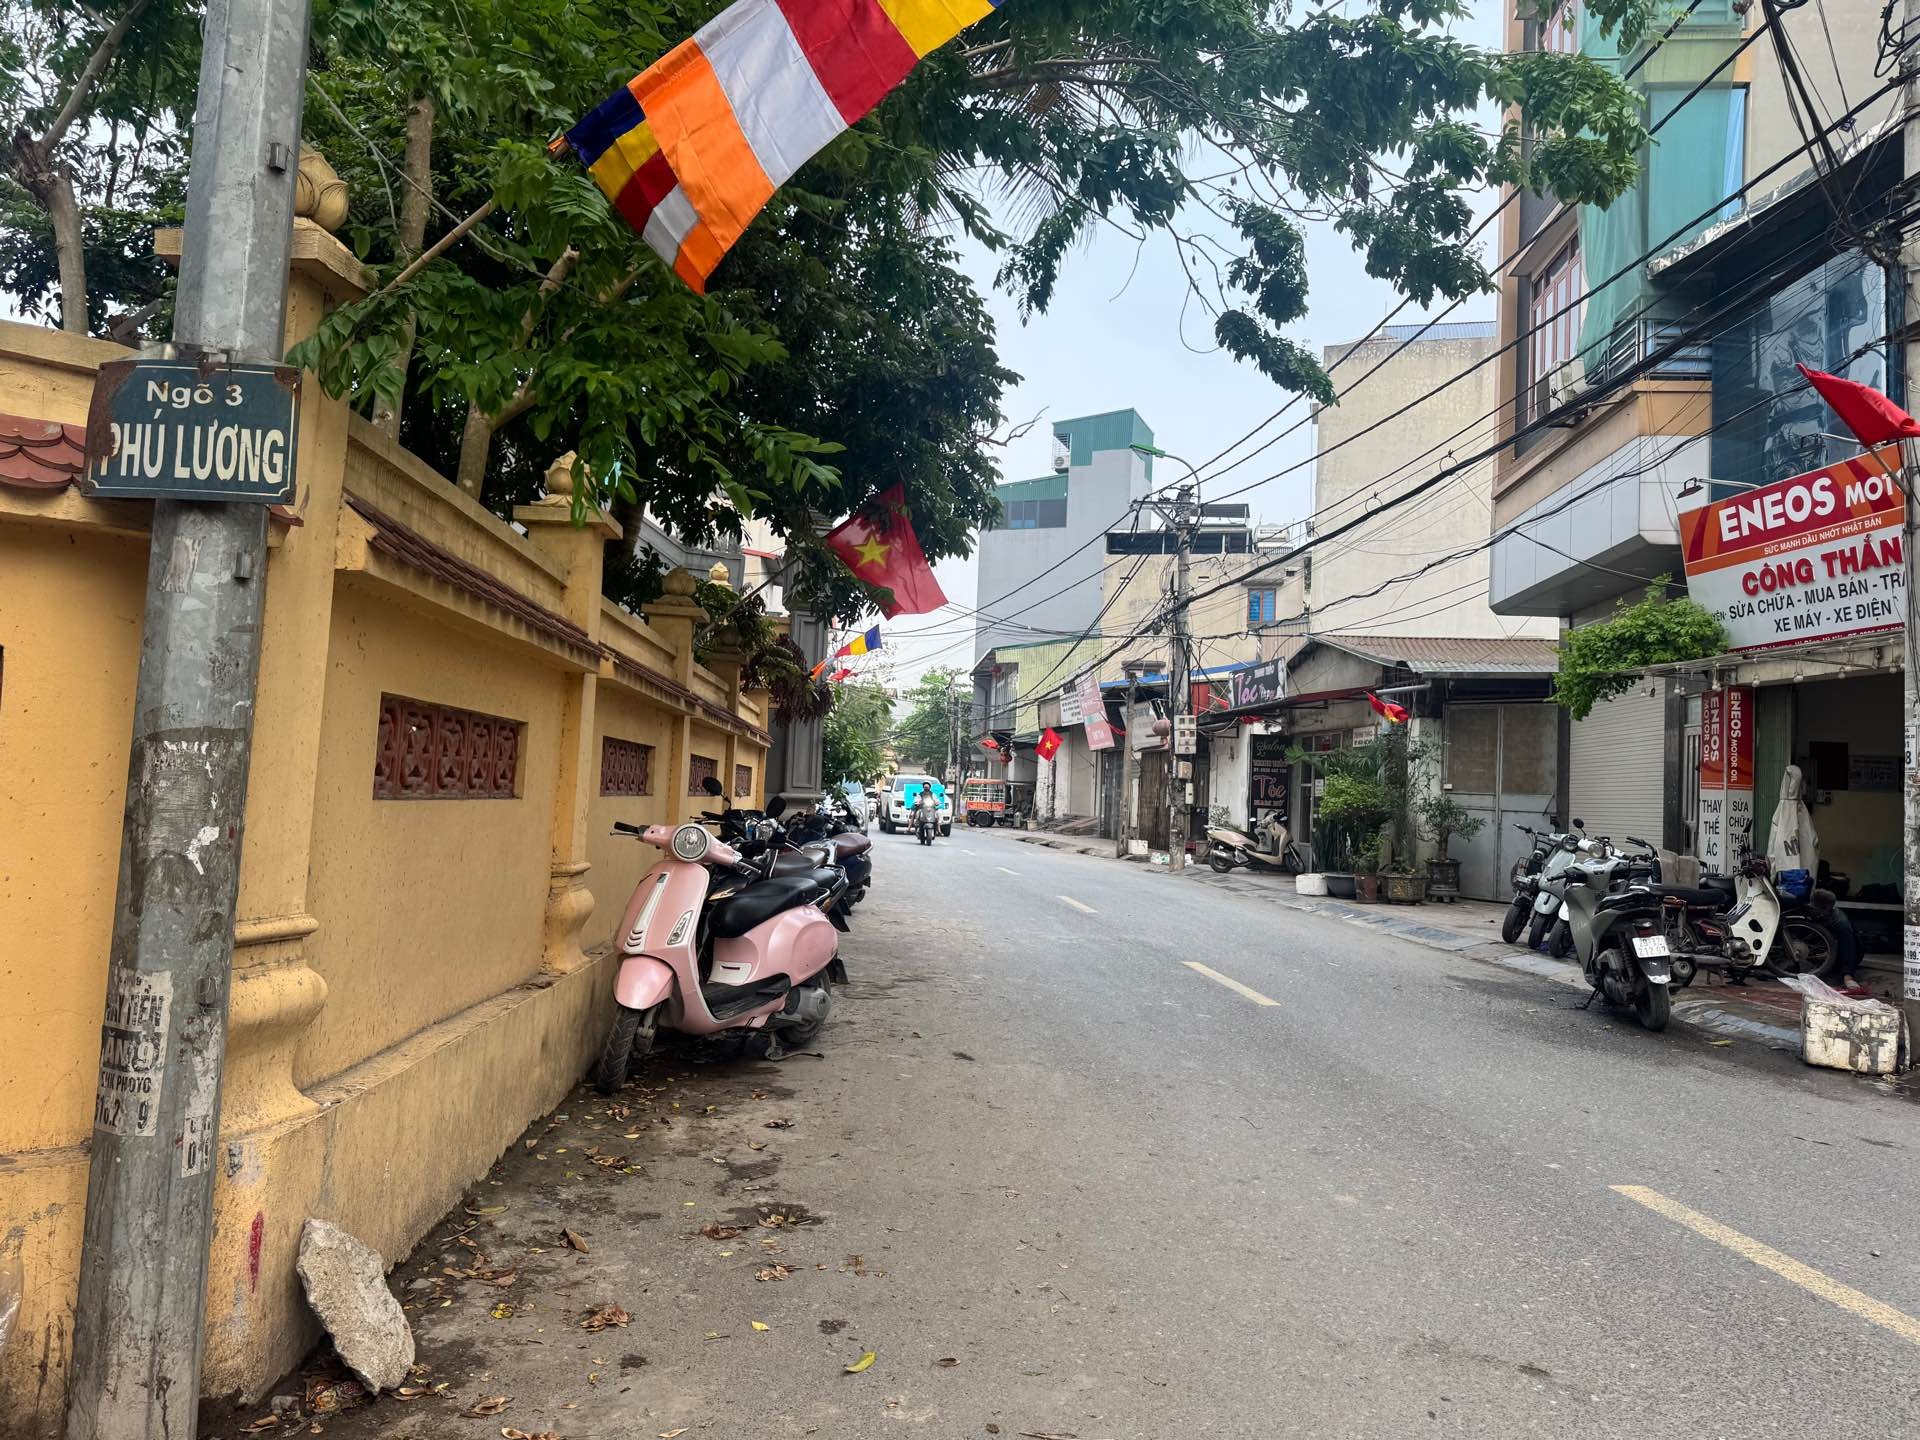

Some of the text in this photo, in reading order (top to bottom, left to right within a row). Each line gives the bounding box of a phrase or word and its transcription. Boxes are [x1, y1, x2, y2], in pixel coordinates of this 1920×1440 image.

[147, 380, 243, 408] Ngõ 3
[100, 408, 285, 485] PHÚ LƯƠNG
[1718, 477, 1836, 542] ENEOS
[1764, 543, 1779, 555] SỨC
[1780, 538, 1801, 552] MẠNH
[1803, 533, 1818, 546] DẦU
[1819, 527, 1840, 540] NHỚT
[1842, 521, 1863, 534] NHẬT
[1742, 533, 1904, 597] CÔNG THẮN
[1729, 601, 1755, 620] SỬA
[1757, 592, 1795, 614] CHỮA
[1804, 586, 1835, 605] MUA
[1838, 576, 1869, 598] BÁN
[1774, 617, 1791, 633] XE
[1794, 609, 1822, 631] MÁY
[1834, 606, 1852, 623] XE
[1856, 597, 1892, 621] ĐIỆN
[1711, 696, 1720, 762] ENEOS
[1730, 691, 1742, 783] ENEOS MOTOR OIL
[1702, 800, 1722, 814] THAY
[1732, 798, 1749, 812] SỬA
[1704, 815, 1720, 835] THẾ
[1706, 836, 1718, 857] ÁC
